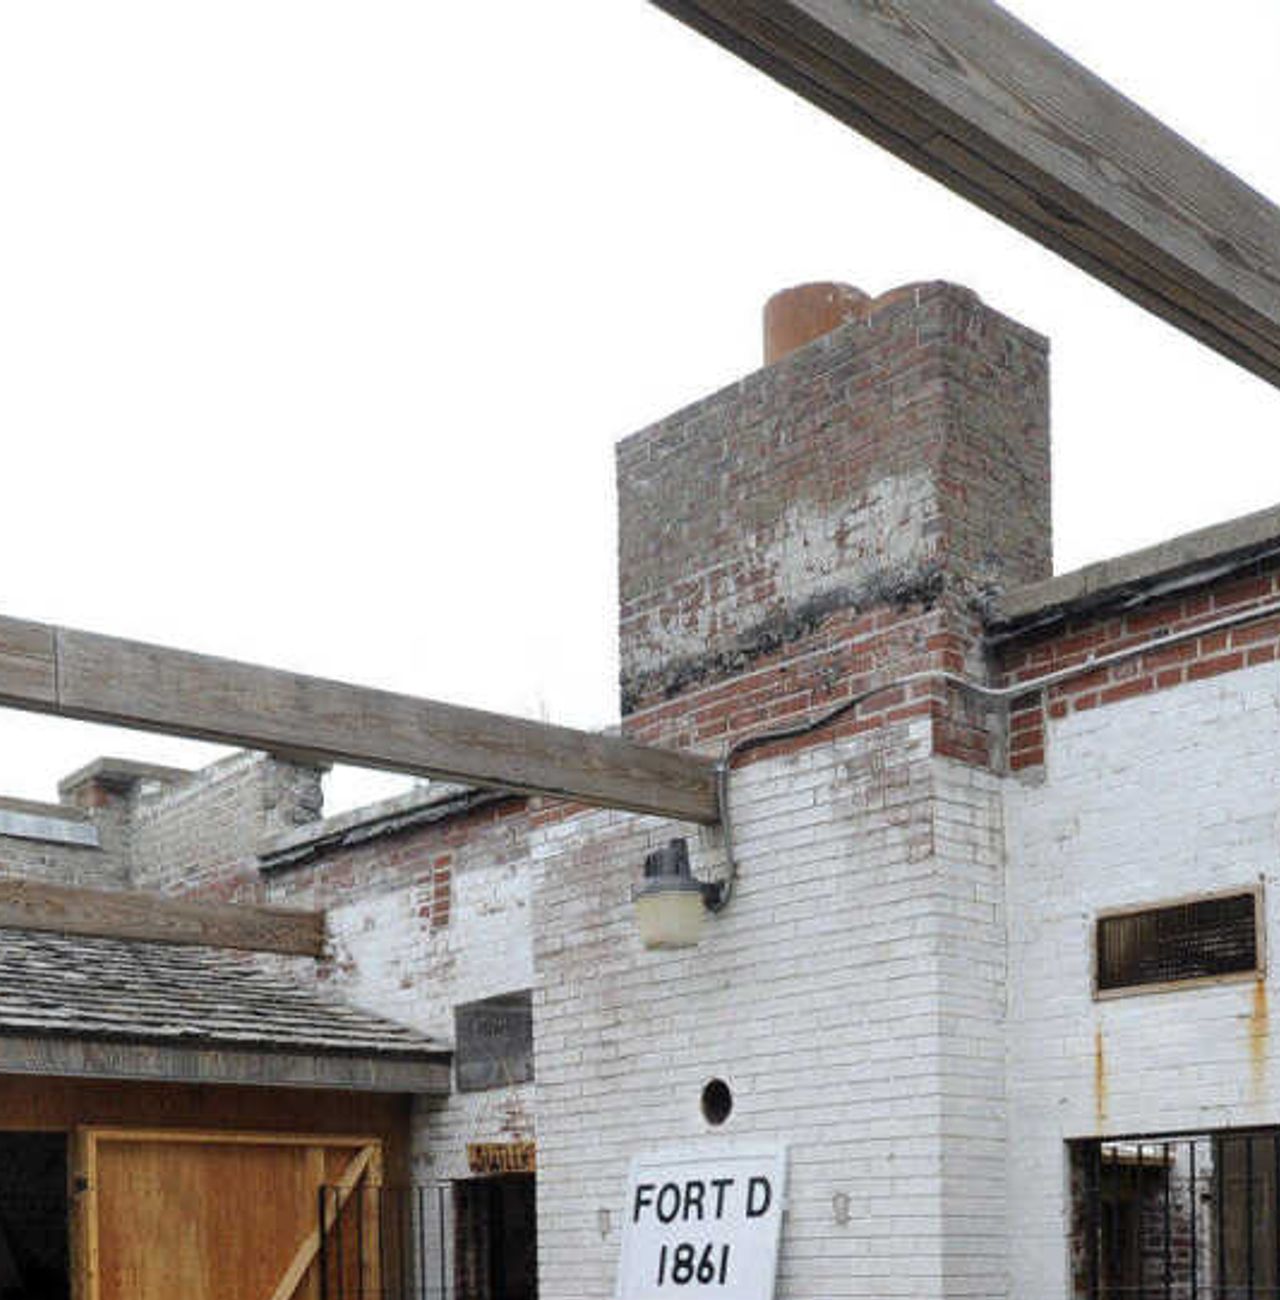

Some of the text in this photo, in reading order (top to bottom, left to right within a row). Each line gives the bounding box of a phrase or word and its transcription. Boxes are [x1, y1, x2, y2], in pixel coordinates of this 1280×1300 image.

[633, 1175, 773, 1224] FORT D
[656, 1243, 731, 1287] 1861
